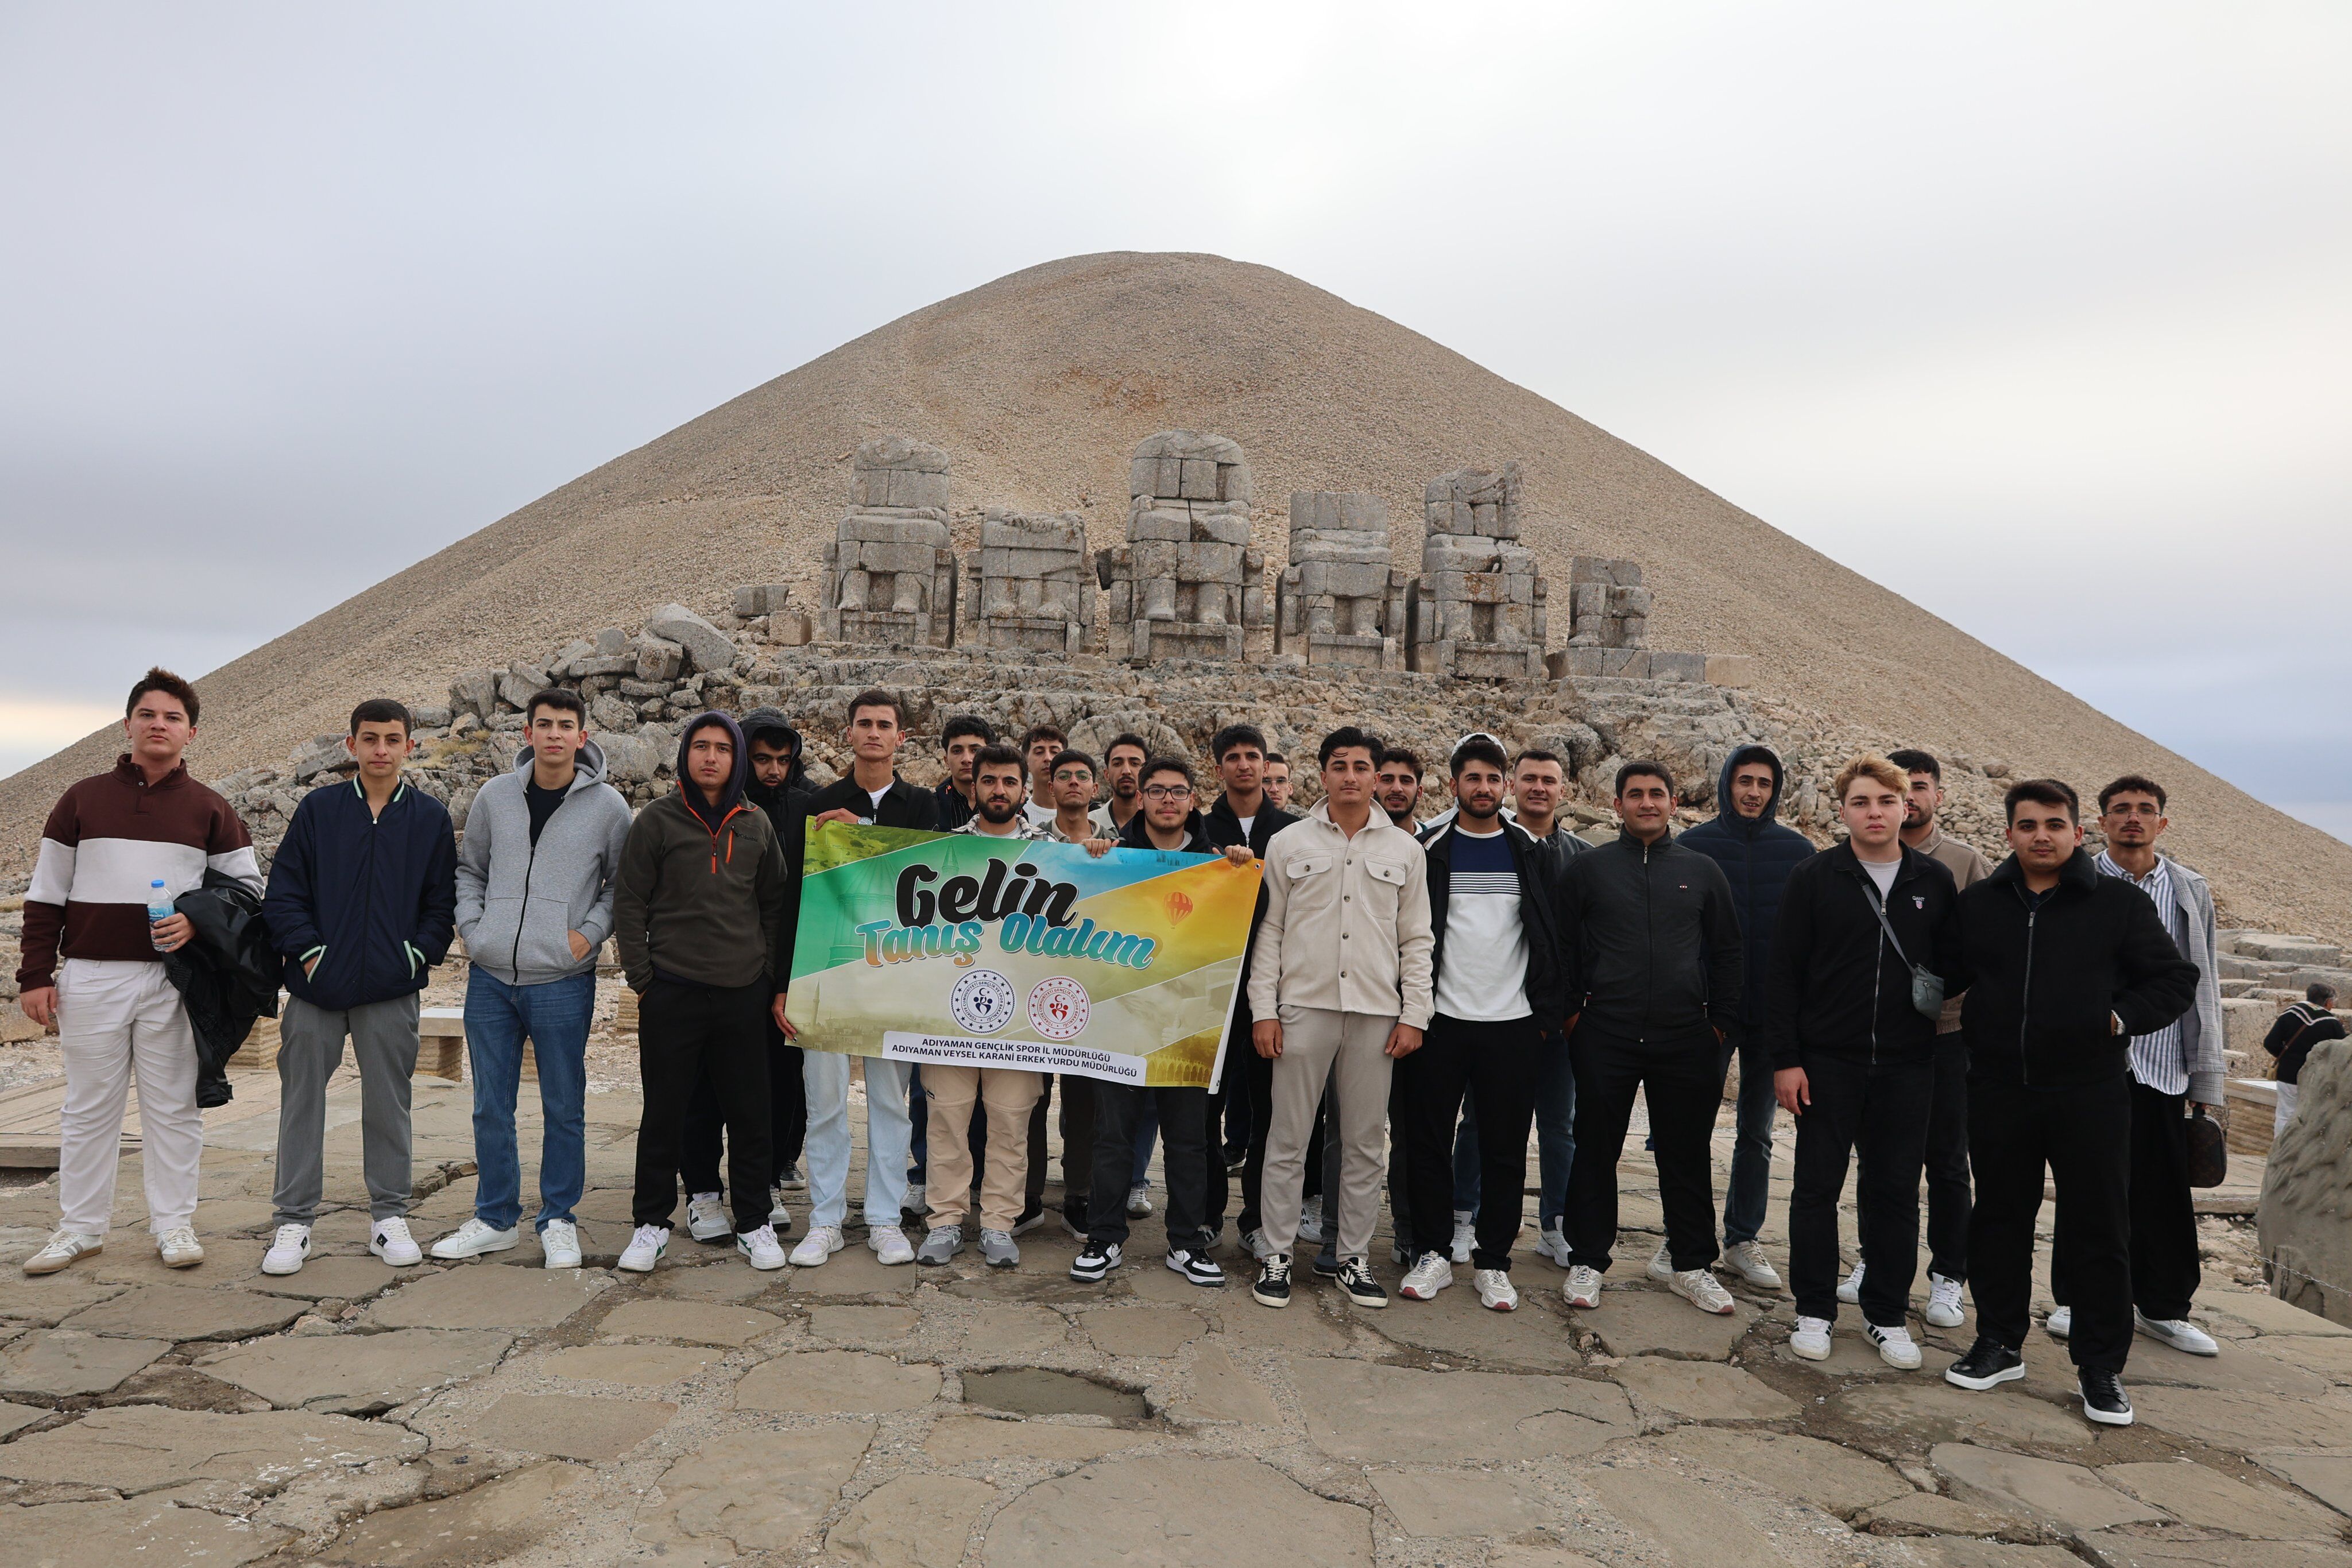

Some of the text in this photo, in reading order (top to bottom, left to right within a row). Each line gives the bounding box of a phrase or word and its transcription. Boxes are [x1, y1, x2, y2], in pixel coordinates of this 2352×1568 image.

[896, 858, 1078, 928] Gelin
[856, 912, 1156, 970] Tanış Olalım
[962, 982, 978, 1006] CUMHURİYETİ
[964, 1007, 977, 1021] TÜRKİYE
[987, 1004, 1003, 1021] BAKANLIĞI
[1063, 1011, 1078, 1027] BAKANLIĞI
[892, 1044, 1137, 1077] ADIYAMAN VEYSEL KARANİ ERKEK YURDU MÜDÜRLÜĞÜ
[922, 1039, 1111, 1062] ADIYAMAN GENÇLİK SPOR İL MÜDÜRLÜĞÜ
